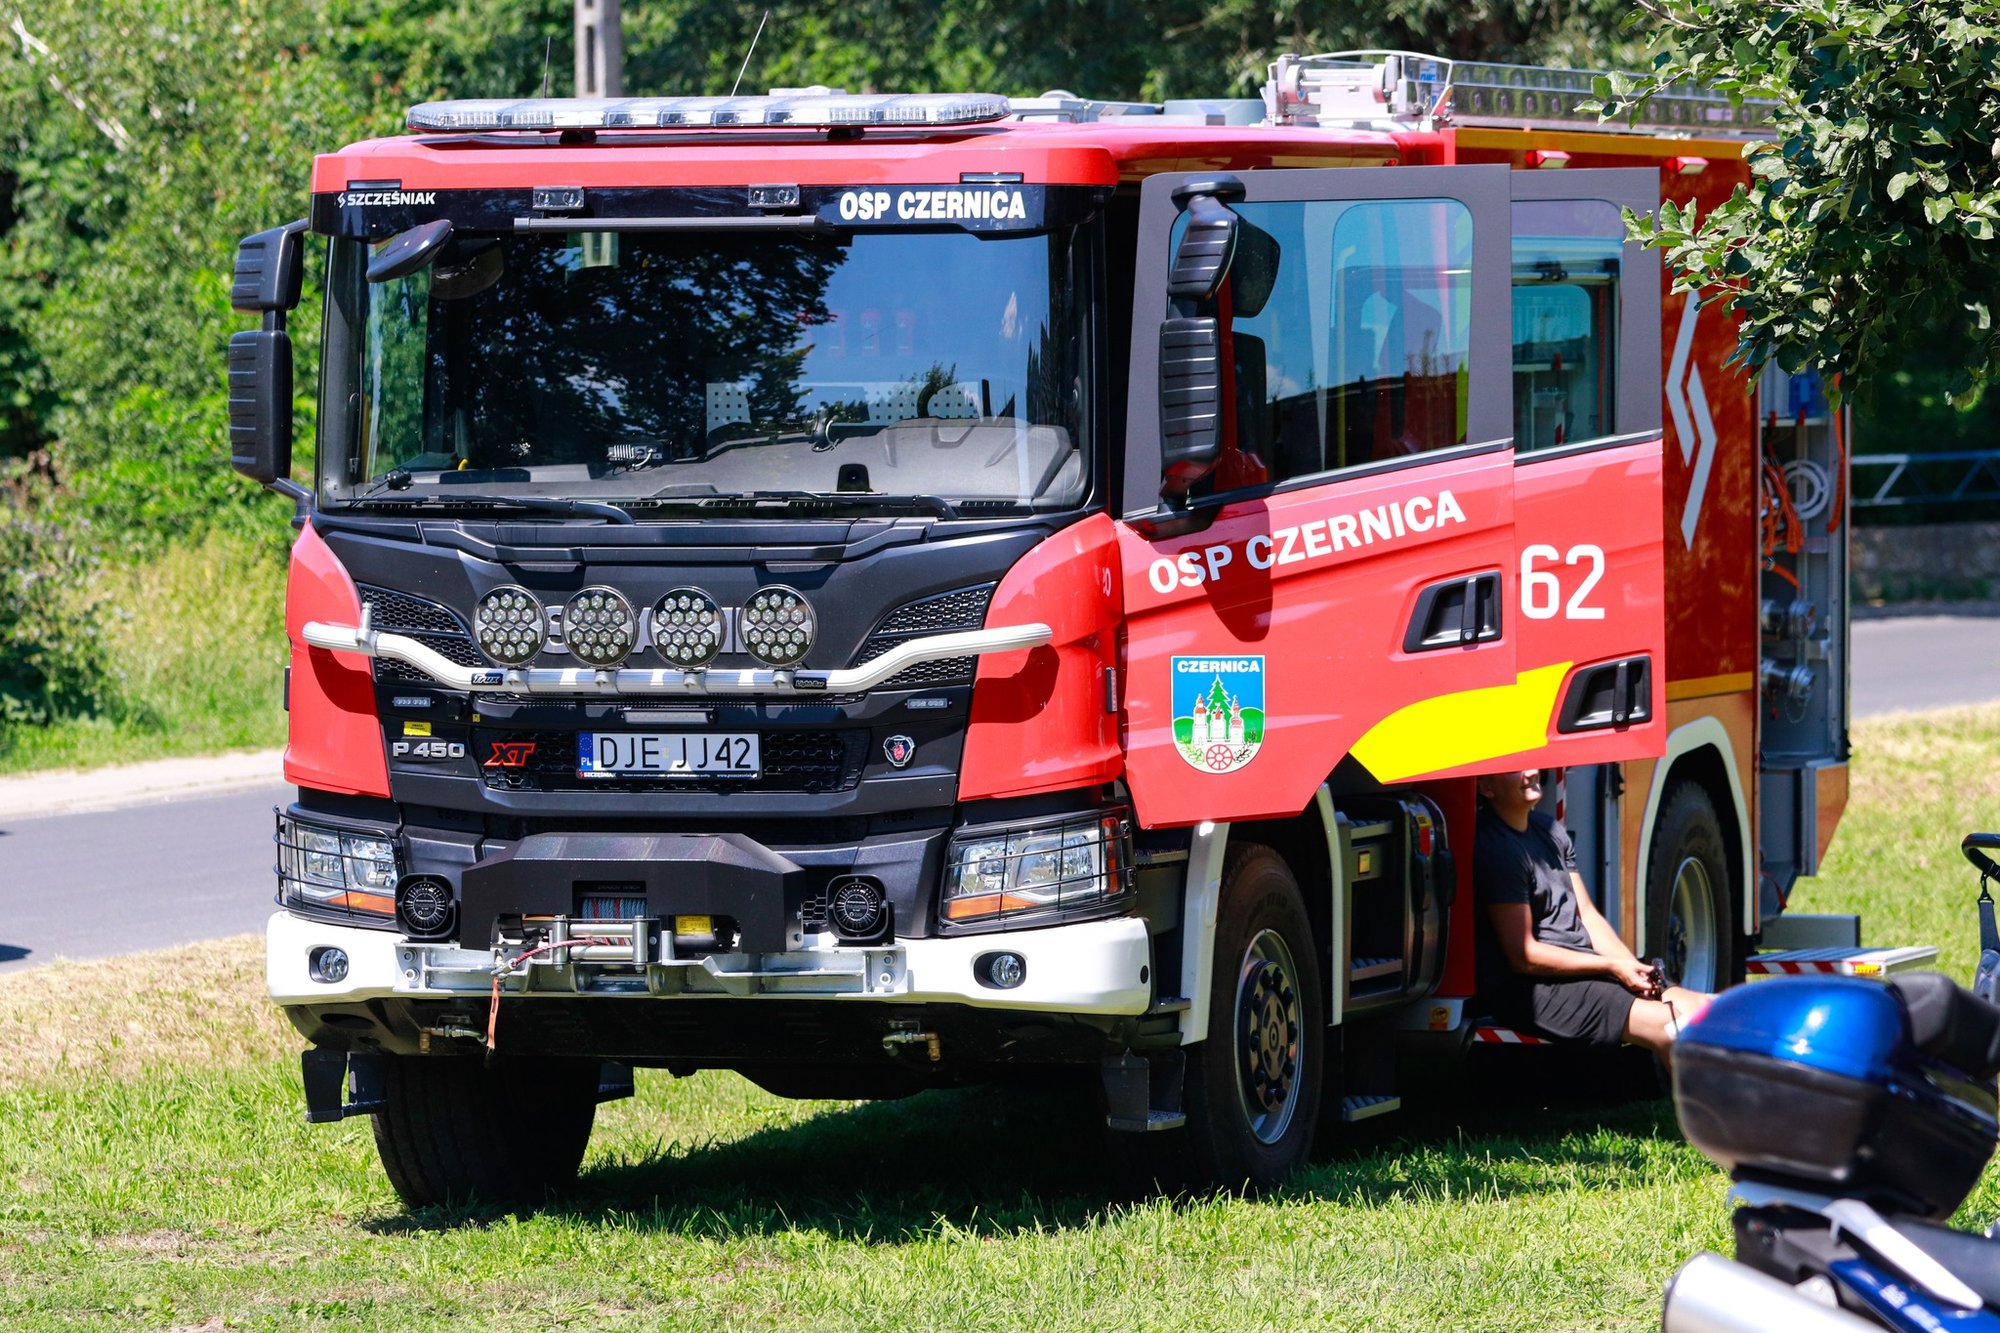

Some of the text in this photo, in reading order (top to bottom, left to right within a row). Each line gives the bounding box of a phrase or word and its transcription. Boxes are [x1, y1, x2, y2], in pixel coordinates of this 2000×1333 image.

[347, 190, 436, 207] SZCZĘŚNIAK
[839, 191, 1026, 220] OSP CZERNICA
[1148, 545, 1233, 594] OSP
[1245, 490, 1467, 570] CZERNICA
[1520, 544, 1605, 620] 62
[1177, 660, 1260, 673] CZERNICA
[392, 742, 465, 758] P 450
[483, 743, 536, 766] XT
[580, 757, 592, 766] PL
[600, 737, 751, 768] DJE JJ42
